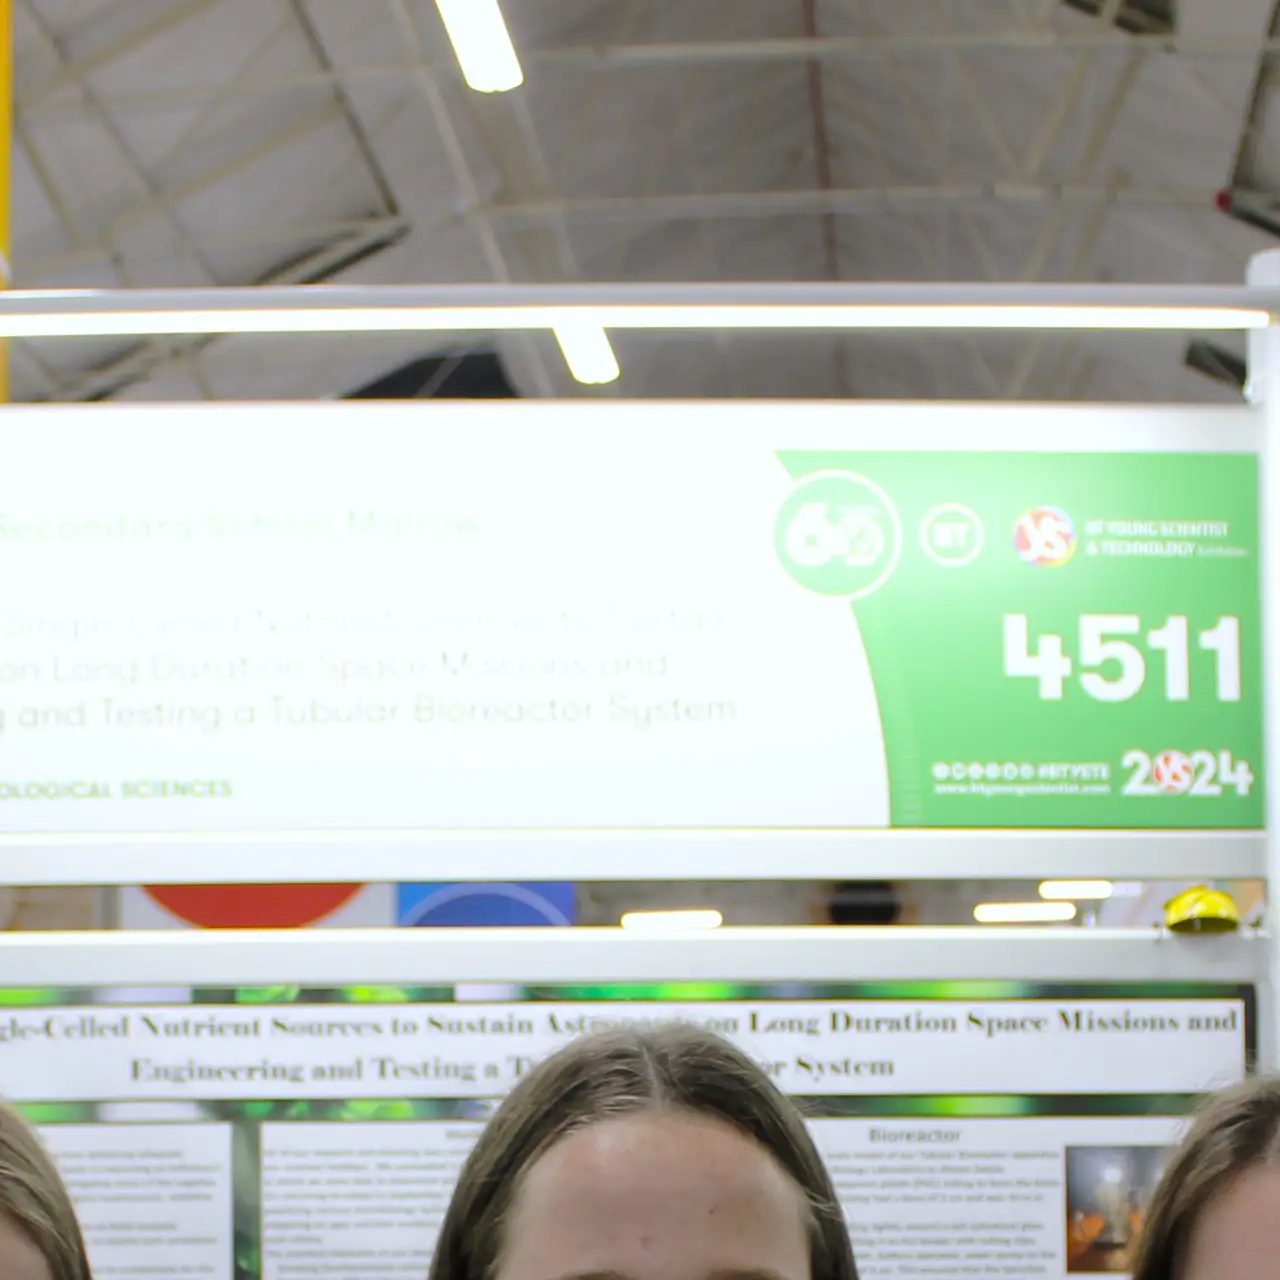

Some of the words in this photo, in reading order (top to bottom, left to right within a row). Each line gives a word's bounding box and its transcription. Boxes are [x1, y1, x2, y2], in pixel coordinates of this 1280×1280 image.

[934, 523, 966, 547] BT
[52, 654, 140, 690] Long
[599, 651, 667, 678] and
[1002, 612, 1240, 702] 4511
[17, 700, 87, 728] and
[100, 696, 220, 736] Testing
[234, 703, 255, 727] a
[270, 693, 402, 725] Tubular
[413, 692, 592, 724] Bioreactor
[609, 690, 738, 733] System
[120, 779, 234, 800] SCIENCES
[140, 1015, 262, 1037] Nutrient
[271, 1015, 384, 1036] Sources
[392, 1015, 418, 1036] to
[428, 1013, 534, 1035] Sustain
[706, 1017, 739, 1033] on
[748, 1010, 821, 1036] Long
[831, 1010, 958, 1033] Duration
[967, 1009, 1049, 1038] Space
[1058, 1009, 1180, 1031] Missions
[1187, 1009, 1239, 1032] and
[131, 1058, 303, 1084] Engineering
[311, 1057, 364, 1081] and
[371, 1056, 476, 1082] Testing
[483, 1062, 500, 1079] a
[795, 1055, 894, 1084] System
[868, 1126, 963, 1145] Bioreactor
